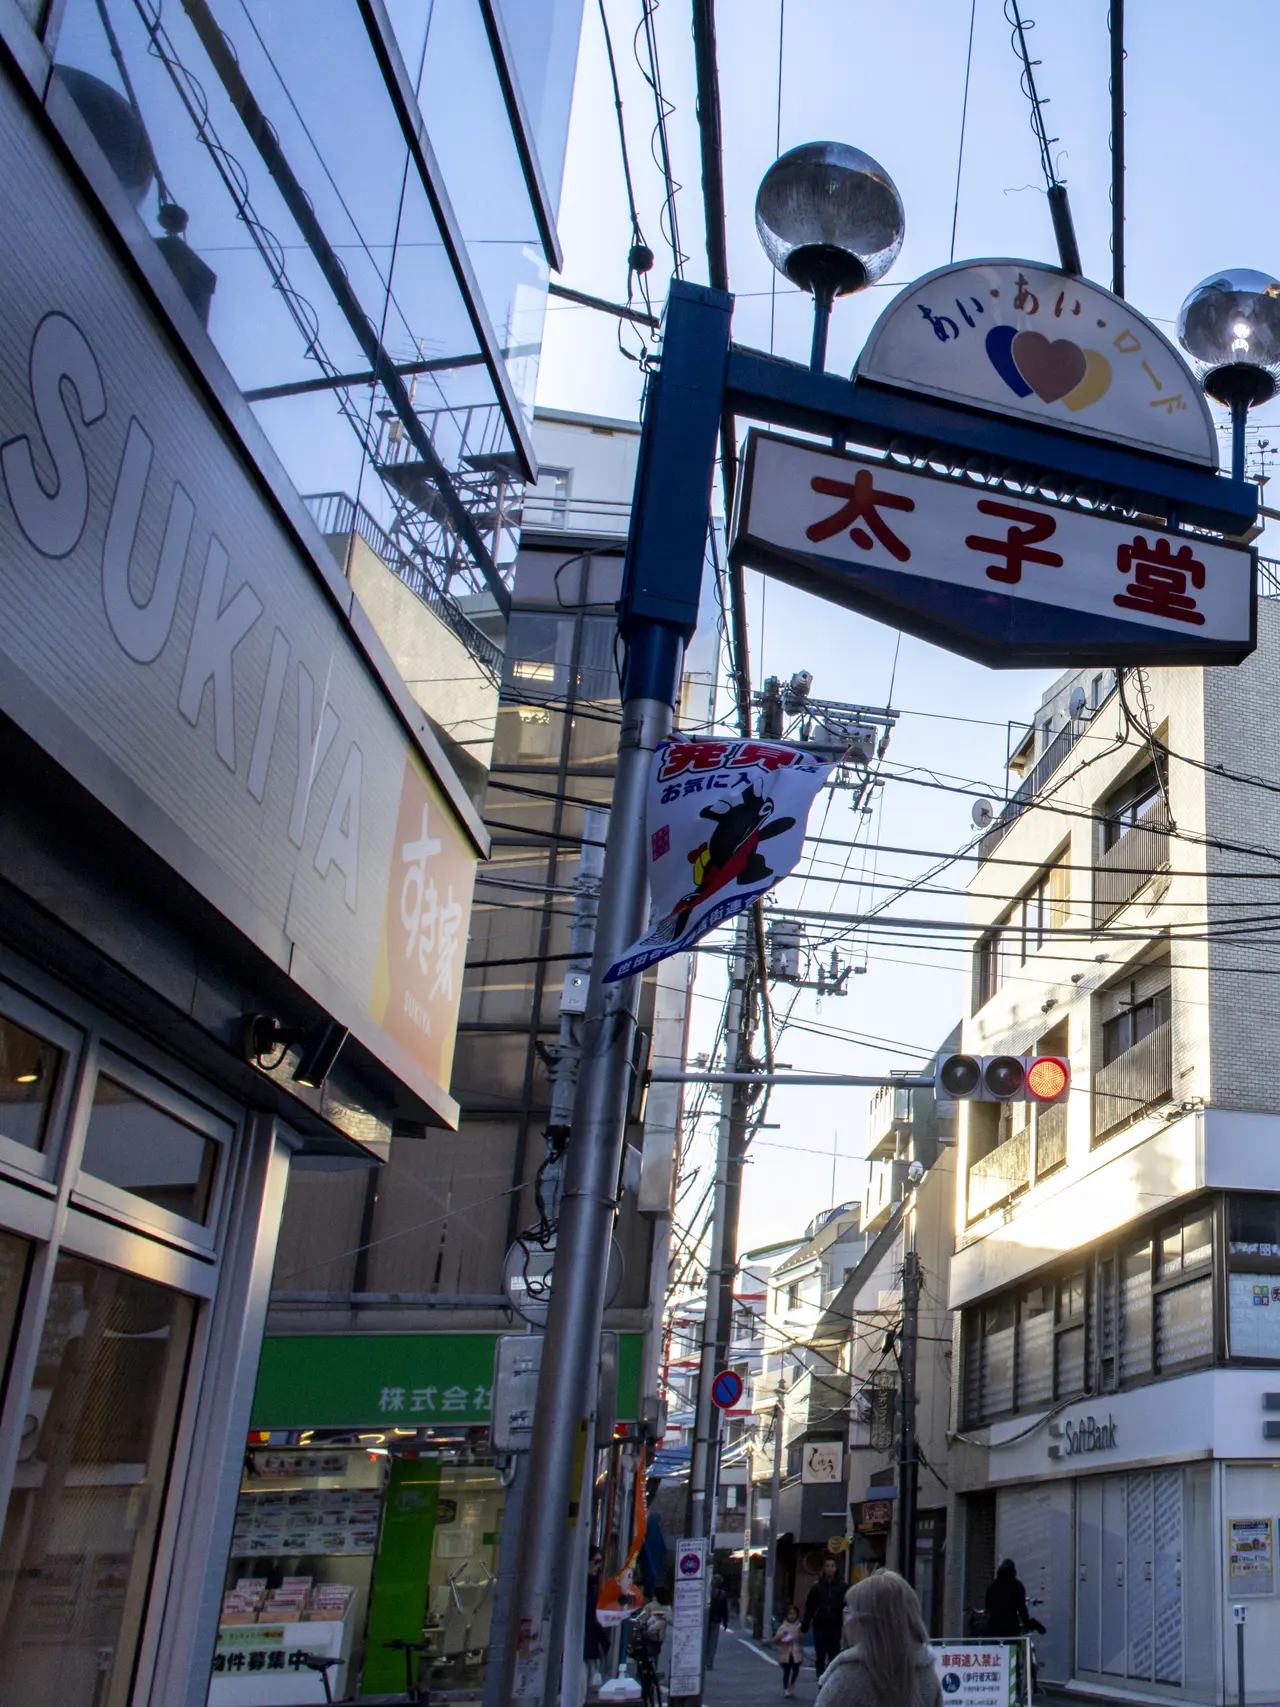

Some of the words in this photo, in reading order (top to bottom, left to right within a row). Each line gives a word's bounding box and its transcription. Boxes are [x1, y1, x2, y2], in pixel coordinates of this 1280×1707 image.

[2, 311, 364, 914] SUKIYA
[806, 469, 1206, 627] 太子堂
[400, 802, 464, 1002] すき家
[403, 989, 432, 1036] SUKIYA
[1065, 1413, 1118, 1456] SoftBank
